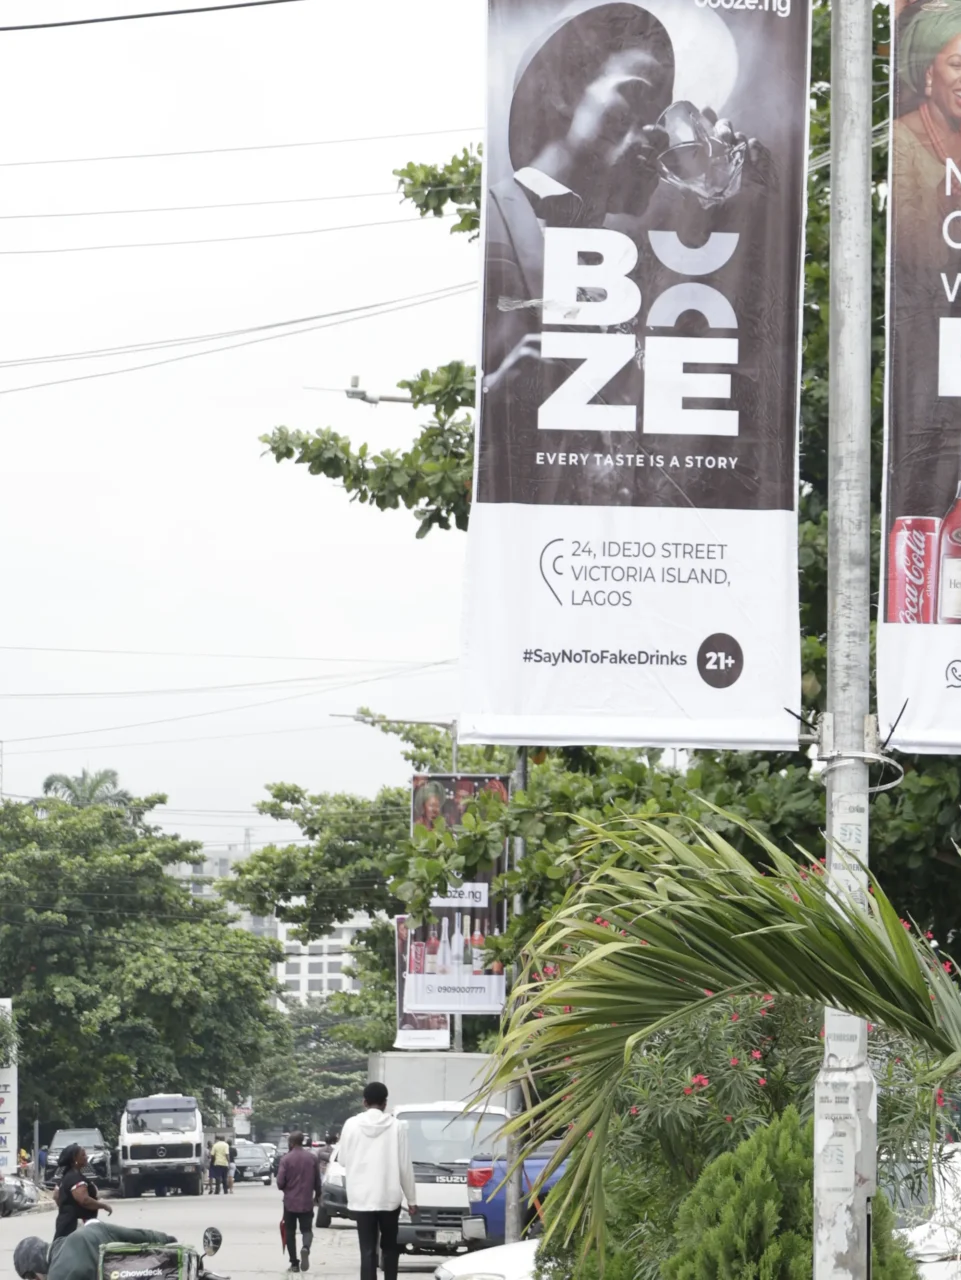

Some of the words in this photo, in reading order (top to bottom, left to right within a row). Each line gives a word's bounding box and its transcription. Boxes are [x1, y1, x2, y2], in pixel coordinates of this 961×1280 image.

[536, 452, 589, 466] EVERY
[594, 453, 645, 467] TASTE
[650, 455, 664, 467] IS
[669, 455, 680, 468] A
[685, 456, 739, 469] STORY
[571, 540, 597, 559] 24,
[602, 542, 656, 559] IDEJO
[661, 543, 728, 560] STREET
[571, 565, 656, 583] VICTORIA
[661, 568, 731, 587] ISLAND,
[571, 590, 632, 607] LAGOS
[523, 649, 687, 666] #SayNoToFakeDrinks
[705, 652, 735, 670] 21+
[431, 889, 482, 903] oze.ng
[120, 1268, 163, 1278] Chowdeck
